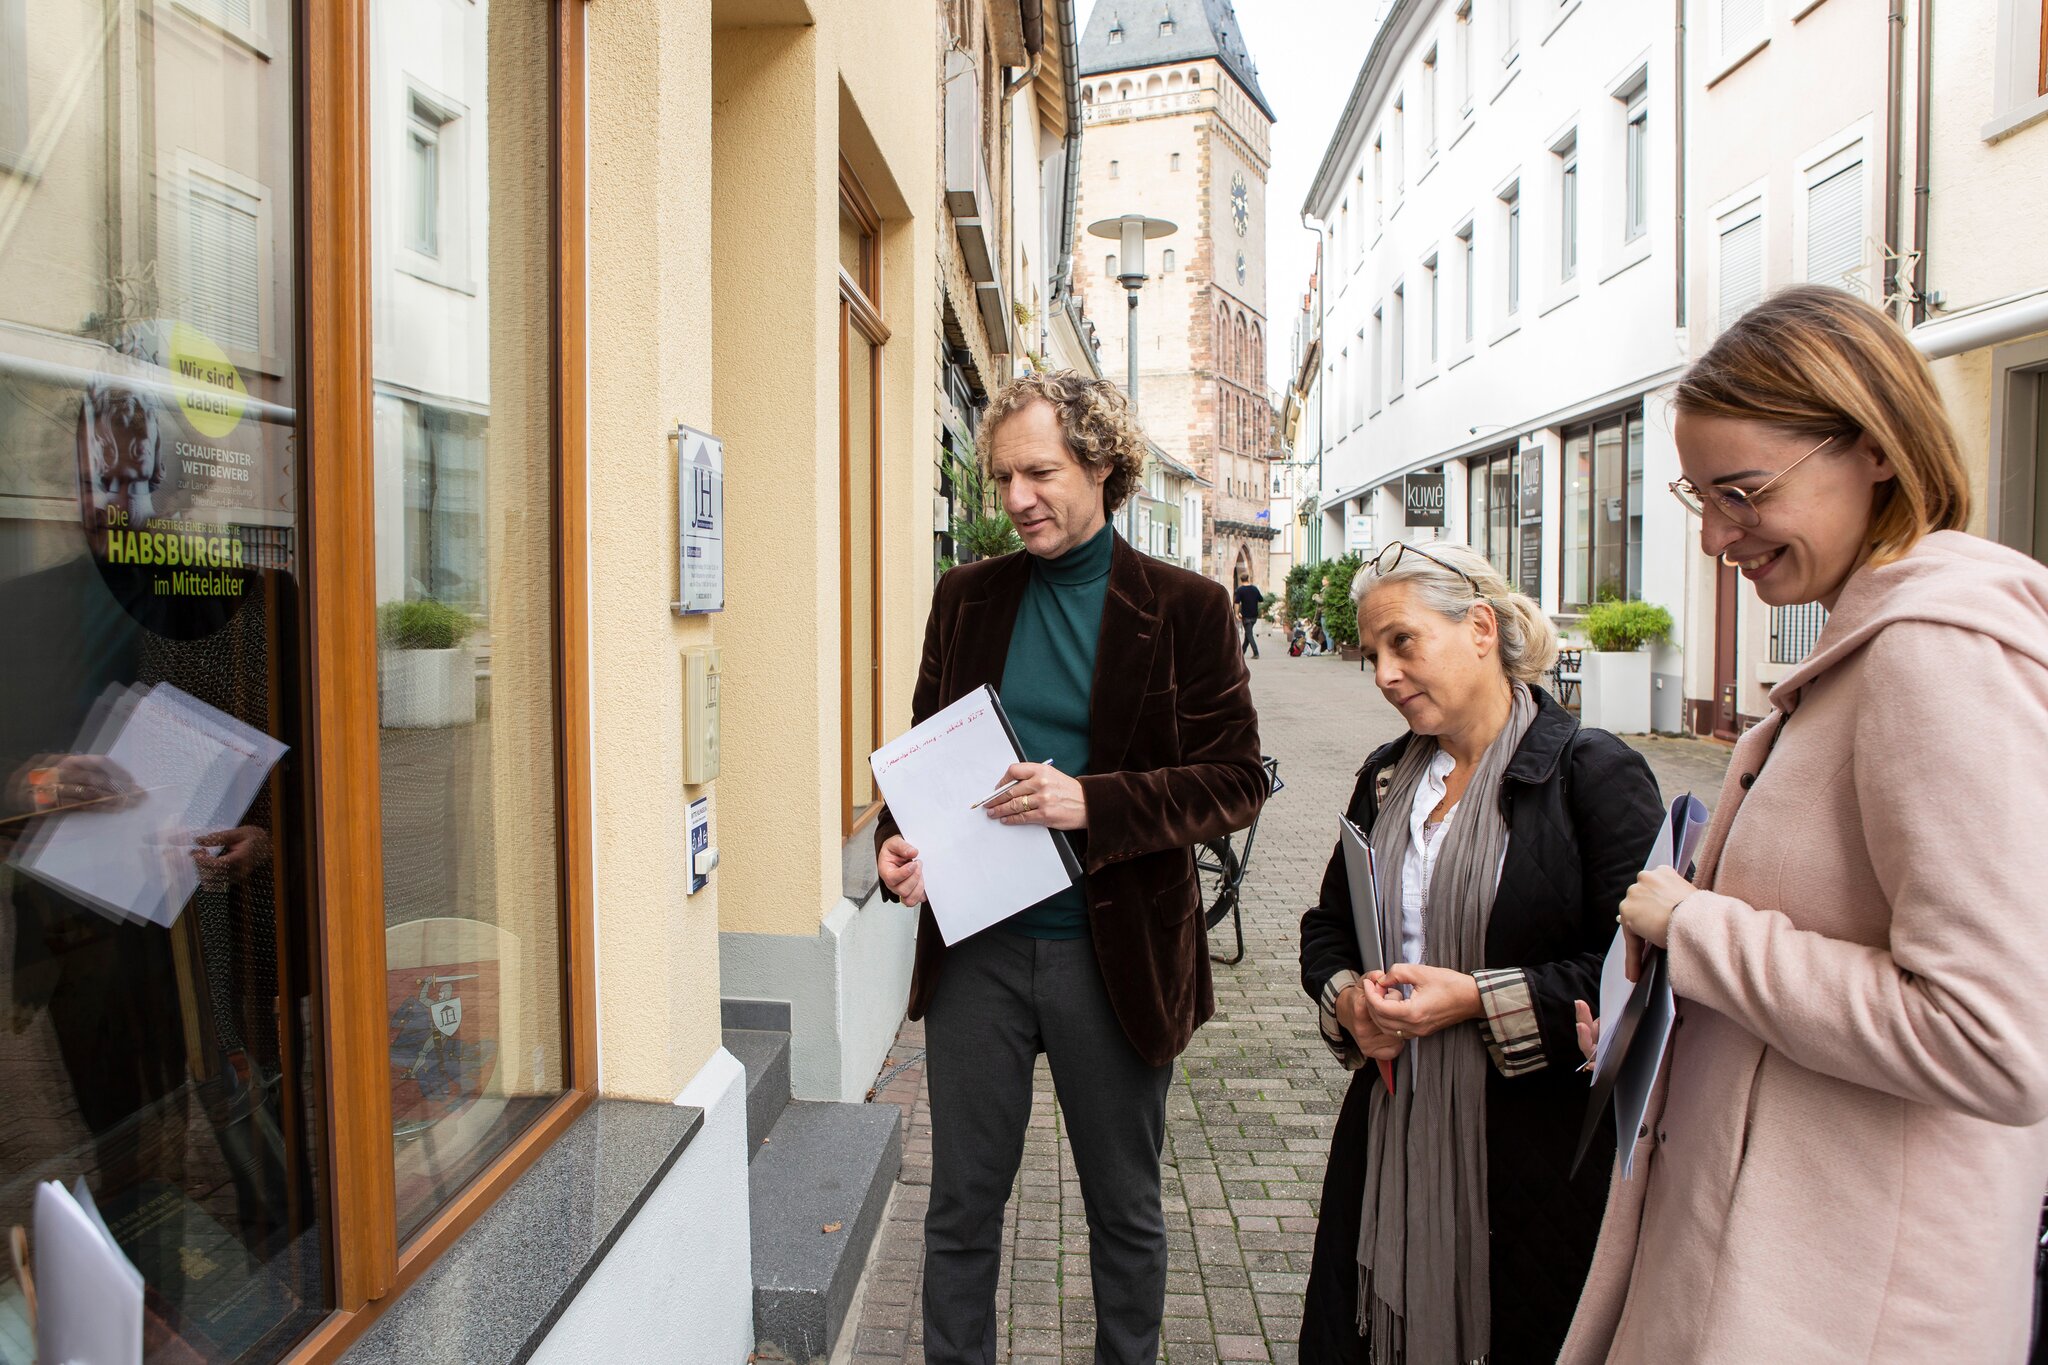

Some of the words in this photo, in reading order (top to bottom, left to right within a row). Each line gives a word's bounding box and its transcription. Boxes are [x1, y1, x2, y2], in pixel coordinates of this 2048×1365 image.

[179, 360, 203, 380] Wir
[207, 367, 234, 390] sind
[187, 390, 228, 416] dabei!
[175, 442, 254, 466] SCHAUFENSTER-
[182, 460, 249, 482] WETTBEWERB
[177, 481, 190, 489] zur
[1407, 483, 1443, 507] küwé
[107, 505, 129, 526] Die
[146, 518, 183, 531] AUFSTIEG
[185, 521, 207, 533] EINER
[208, 523, 240, 536] DYNASTIE
[108, 529, 244, 568] HABSBURGER
[154, 574, 169, 595] im
[172, 571, 244, 596] Mittelalter
